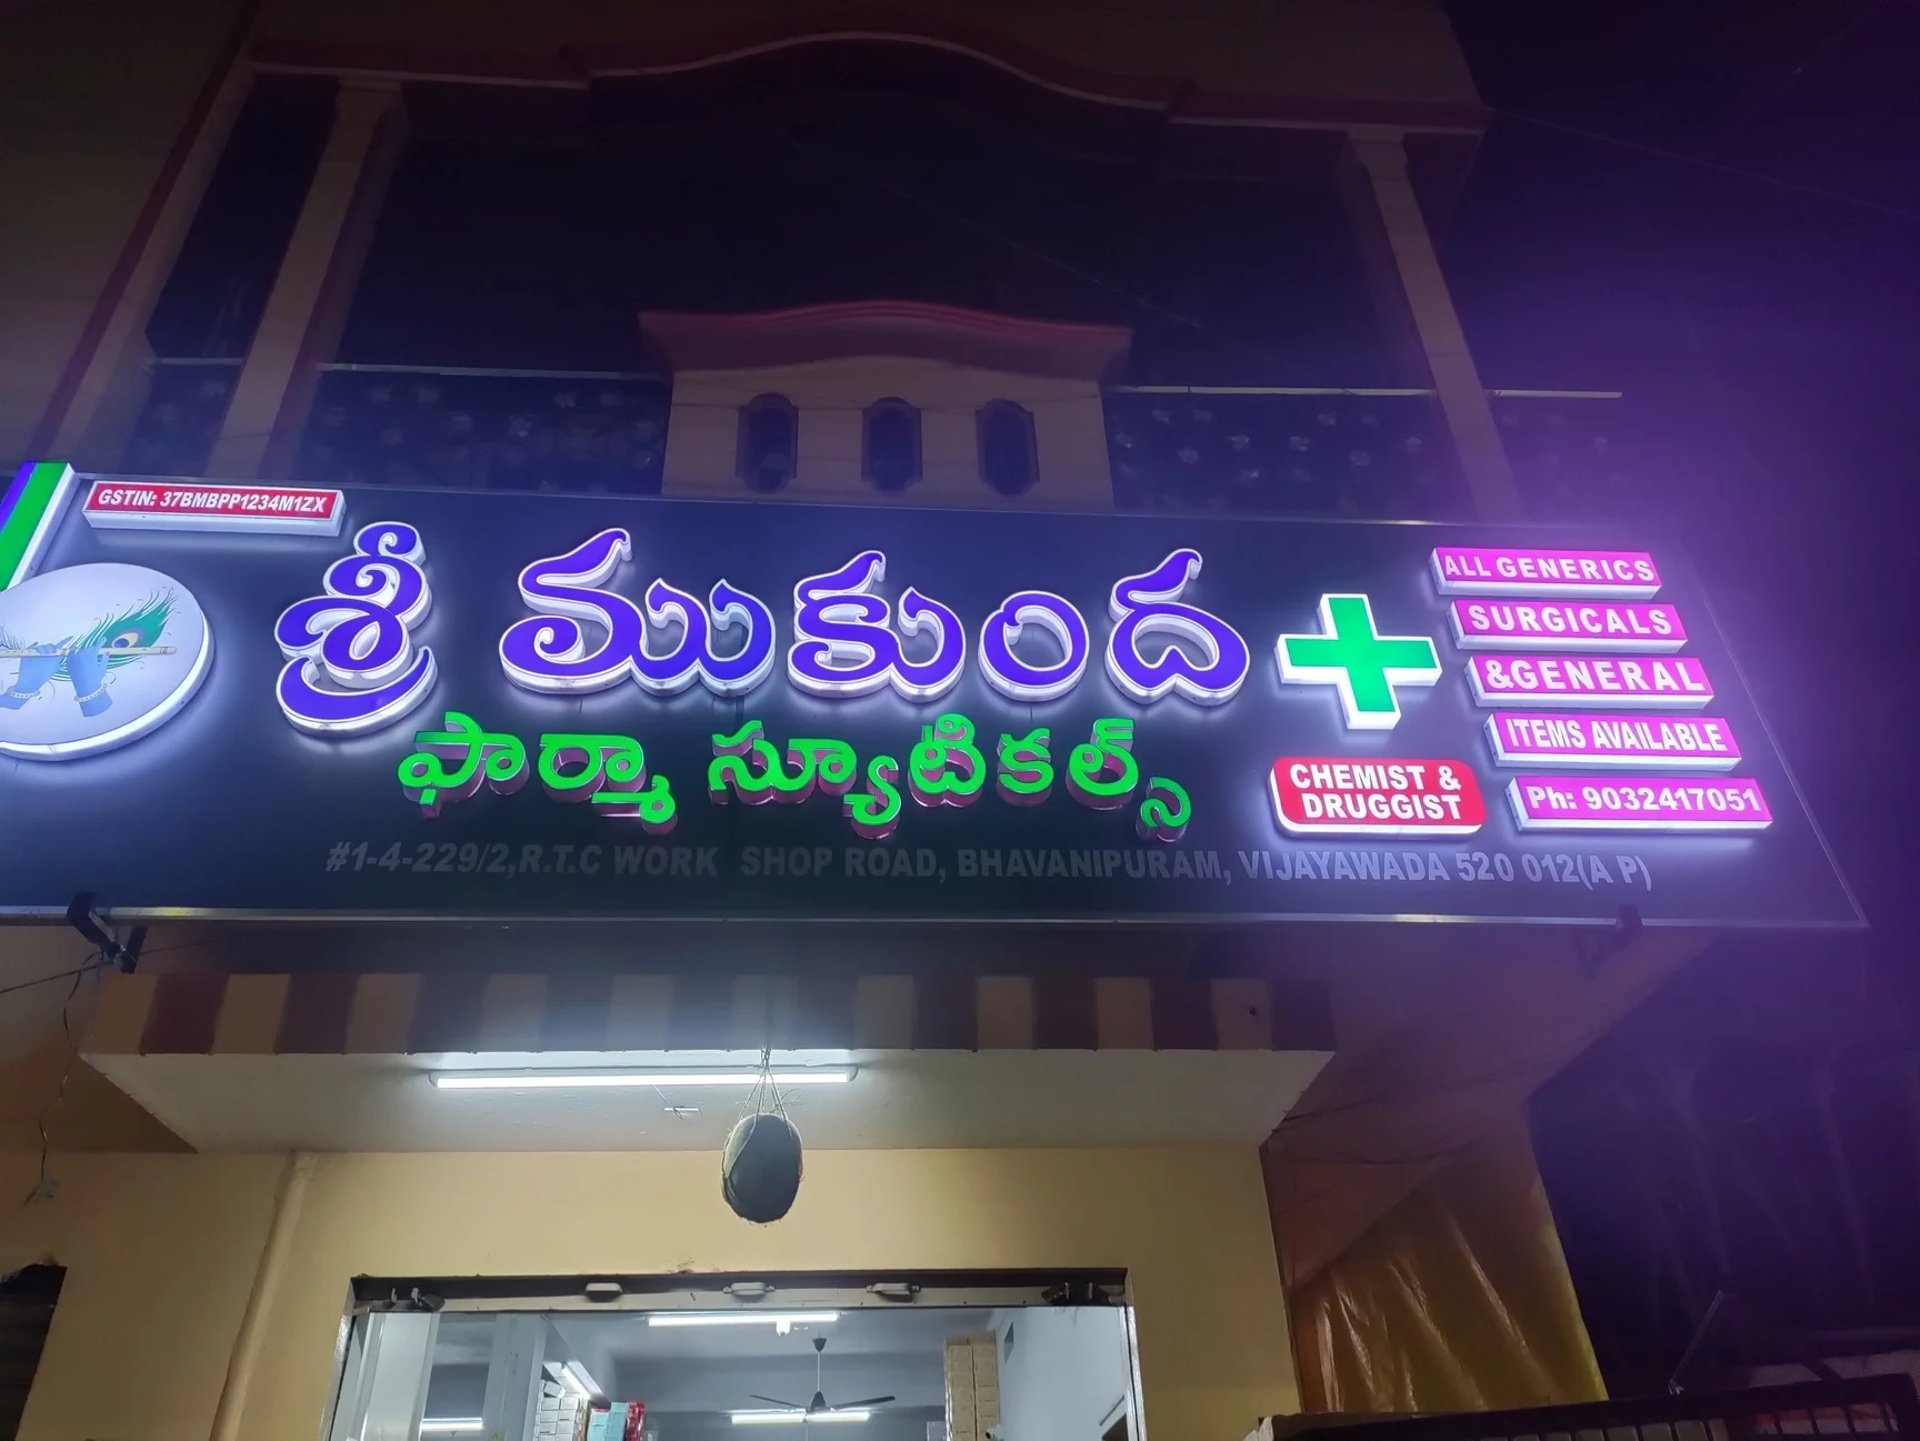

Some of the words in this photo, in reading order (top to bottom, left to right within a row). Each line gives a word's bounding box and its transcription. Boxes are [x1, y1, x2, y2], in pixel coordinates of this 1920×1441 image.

[98, 489, 156, 506] GSTIN:
[160, 491, 328, 513] 37BMBPP1234M1ZX
[1445, 555, 1491, 577] ALL
[1496, 557, 1655, 582] GENERICS
[274, 520, 438, 736] శ్రీ
[499, 526, 1251, 706] ముకుంద
[1467, 605, 1672, 635] SURGICALS
[1484, 660, 1706, 692] &GENERAL
[1506, 718, 1587, 749] ITEMS
[1592, 721, 1729, 752] AVAILABLE
[397, 711, 676, 827] ఫార్మా
[1290, 764, 1425, 790] CHEMIST
[1438, 766, 1462, 791] &
[1303, 793, 1462, 820] DRUGGIST
[1525, 786, 1577, 809] Ph:
[1582, 786, 1762, 812] 9032417051
[614, 845, 720, 876] WORK
[740, 846, 833, 876] SHOP
[844, 848, 947, 883] ROAD,
[957, 848, 1233, 886] BHAVANIPURAM,
[1238, 850, 1451, 882] VIJAYAWADA
[1458, 852, 1515, 883] 520
